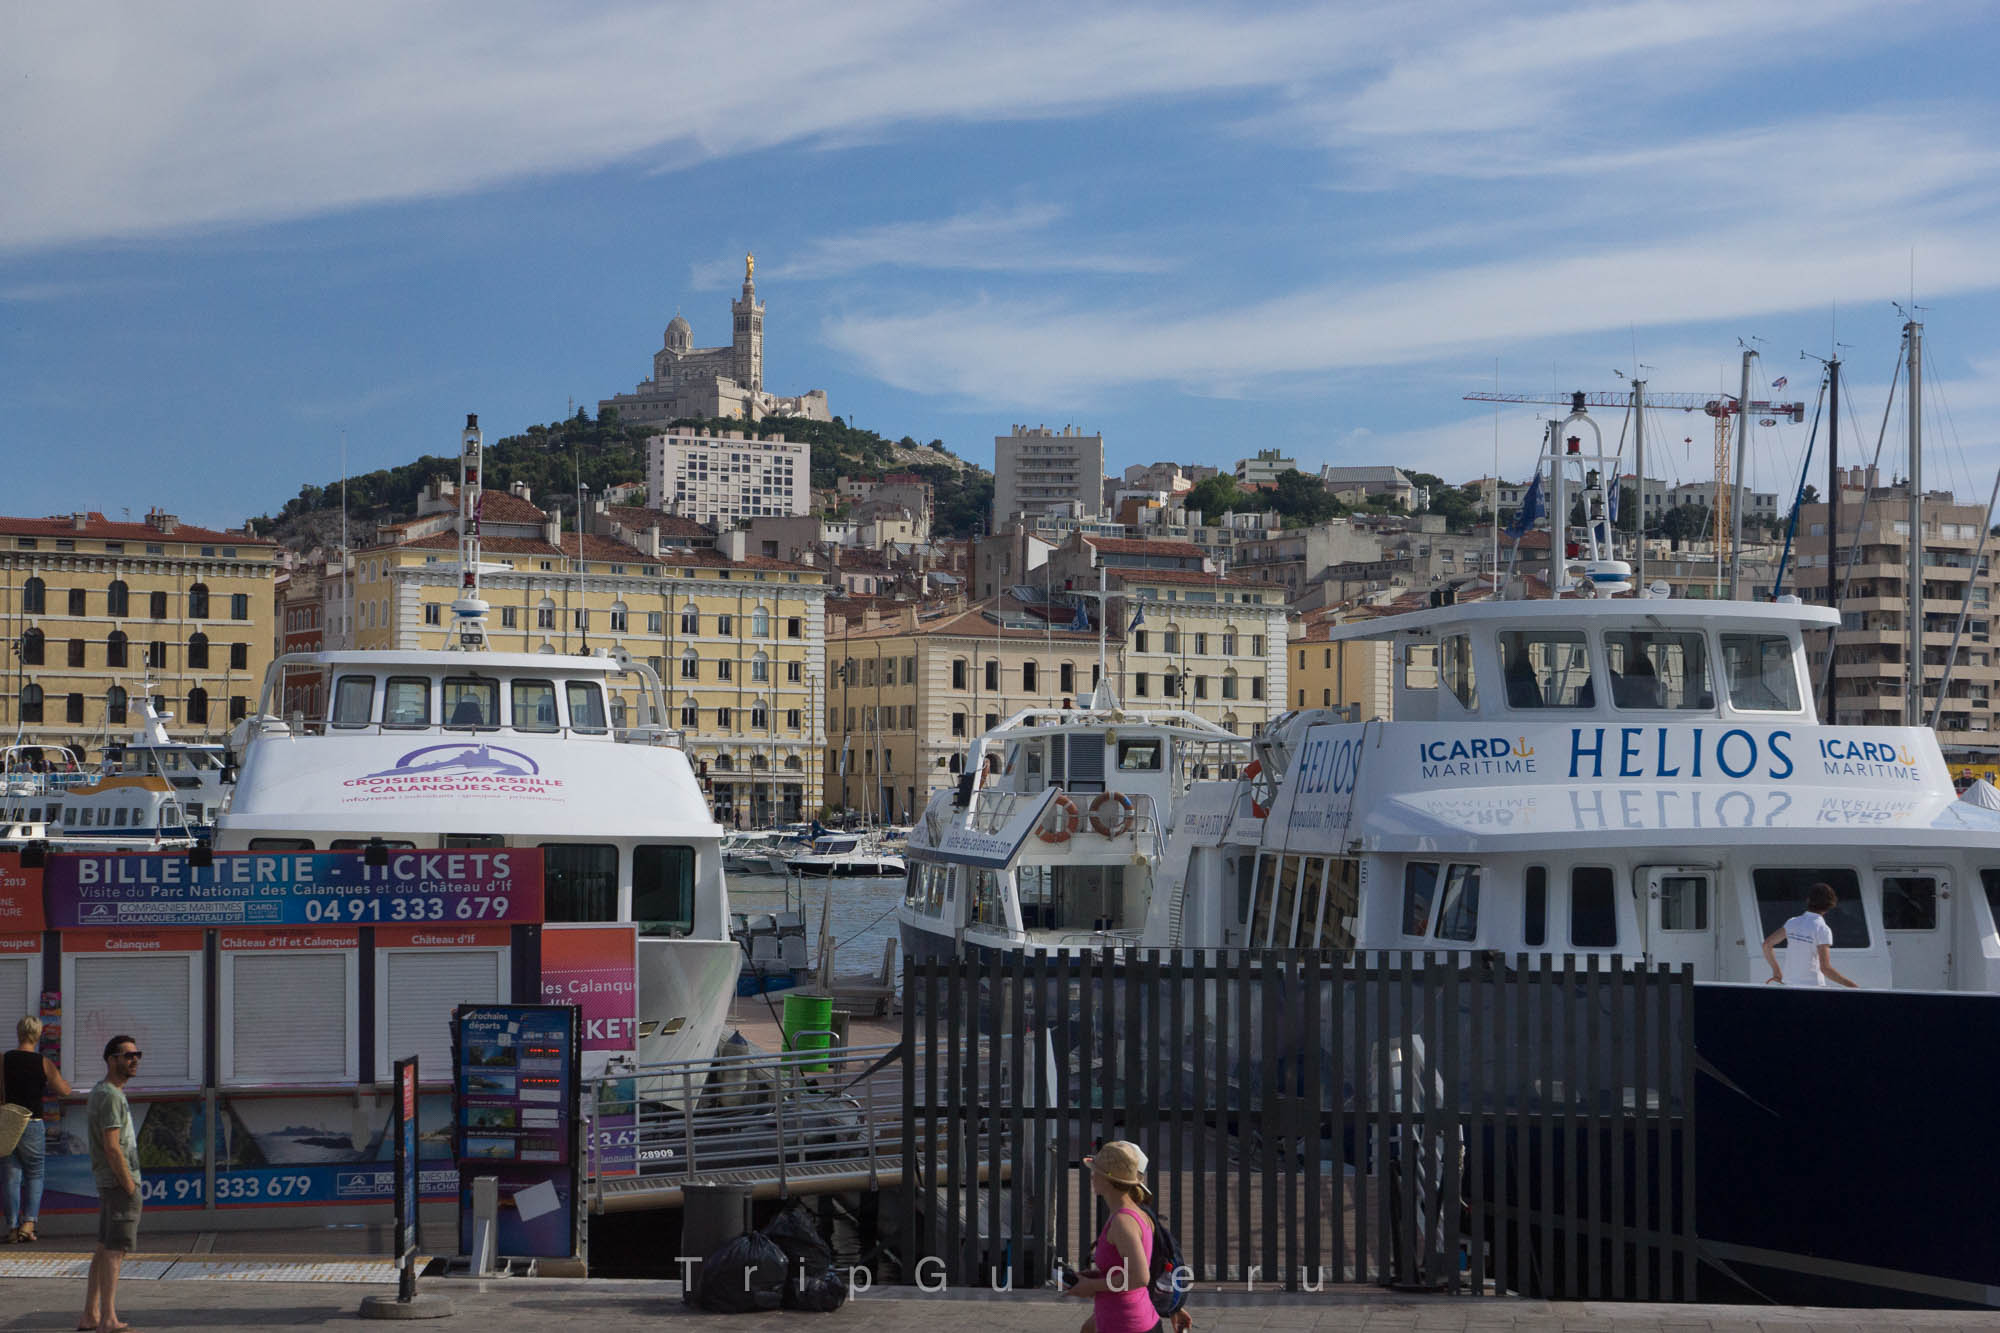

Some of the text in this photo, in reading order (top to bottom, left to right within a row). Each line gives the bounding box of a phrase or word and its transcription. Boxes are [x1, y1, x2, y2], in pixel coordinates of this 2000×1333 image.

[1420, 738, 1510, 763] ICARD
[1568, 728, 1793, 780] HELIOS
[1819, 739, 1896, 763] ICARD
[1300, 738, 1363, 795] HELIOS
[1422, 759, 1537, 779] MARITIME
[1824, 762, 1921, 781] MARITIME
[343, 775, 564, 787] CROISIERES-MARSEILLE
[78, 857, 314, 884] BILLETTERIE
[357, 853, 511, 881] TICKETS
[79, 880, 512, 897] Visite du Parc National des Calanques et du Château d'If
[119, 902, 187, 913] COMPAGNIES
[305, 896, 509, 921] 04 91 333 679
[105, 938, 160, 949] Calanques
[222, 937, 266, 948] Château
[304, 936, 357, 947] Calanques
[411, 935, 453, 946] Château
[568, 979, 637, 994] Calanqu
[582, 1017, 638, 1040] KET
[141, 1176, 311, 1200] 04 91 333 679
